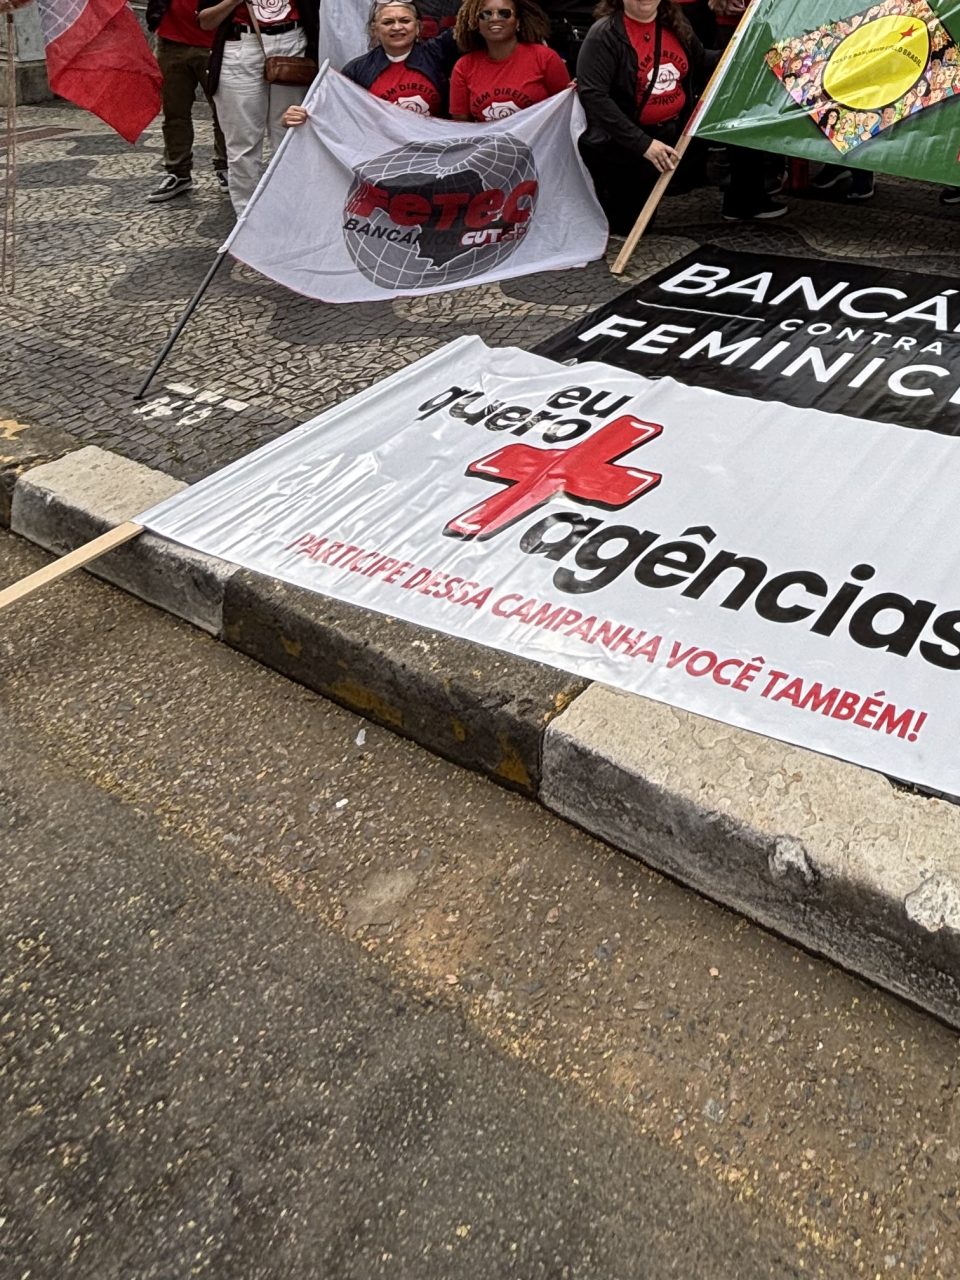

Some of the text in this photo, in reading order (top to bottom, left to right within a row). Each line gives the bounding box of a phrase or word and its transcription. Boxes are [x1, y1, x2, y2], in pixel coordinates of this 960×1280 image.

[779, 319, 943, 356] CONTRA
[413, 385, 592, 444] quero
[546, 385, 635, 419] eu
[285, 532, 928, 743] PARTICIPE DESSA CAMPANHA VOCÊ TAMBÉM!
